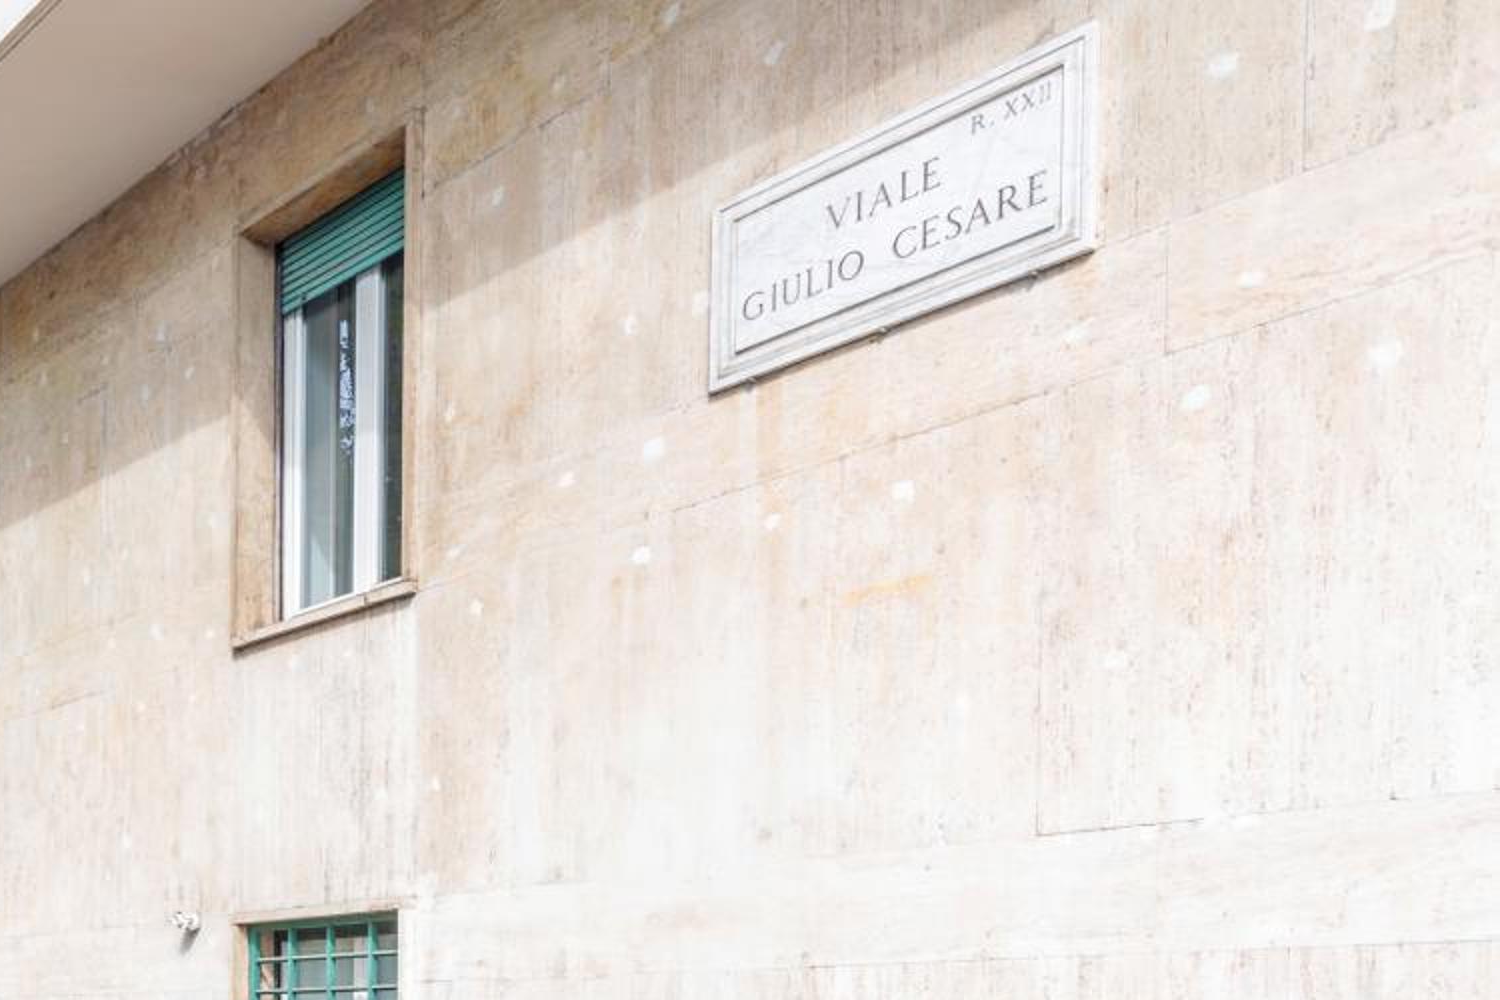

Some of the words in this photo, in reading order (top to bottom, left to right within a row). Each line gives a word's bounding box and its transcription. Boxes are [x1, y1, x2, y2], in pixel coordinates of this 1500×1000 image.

[971, 113, 995, 136] R.
[825, 156, 941, 230] VIALE
[742, 250, 865, 321] GIULIO
[892, 170, 1049, 259] CESARE
